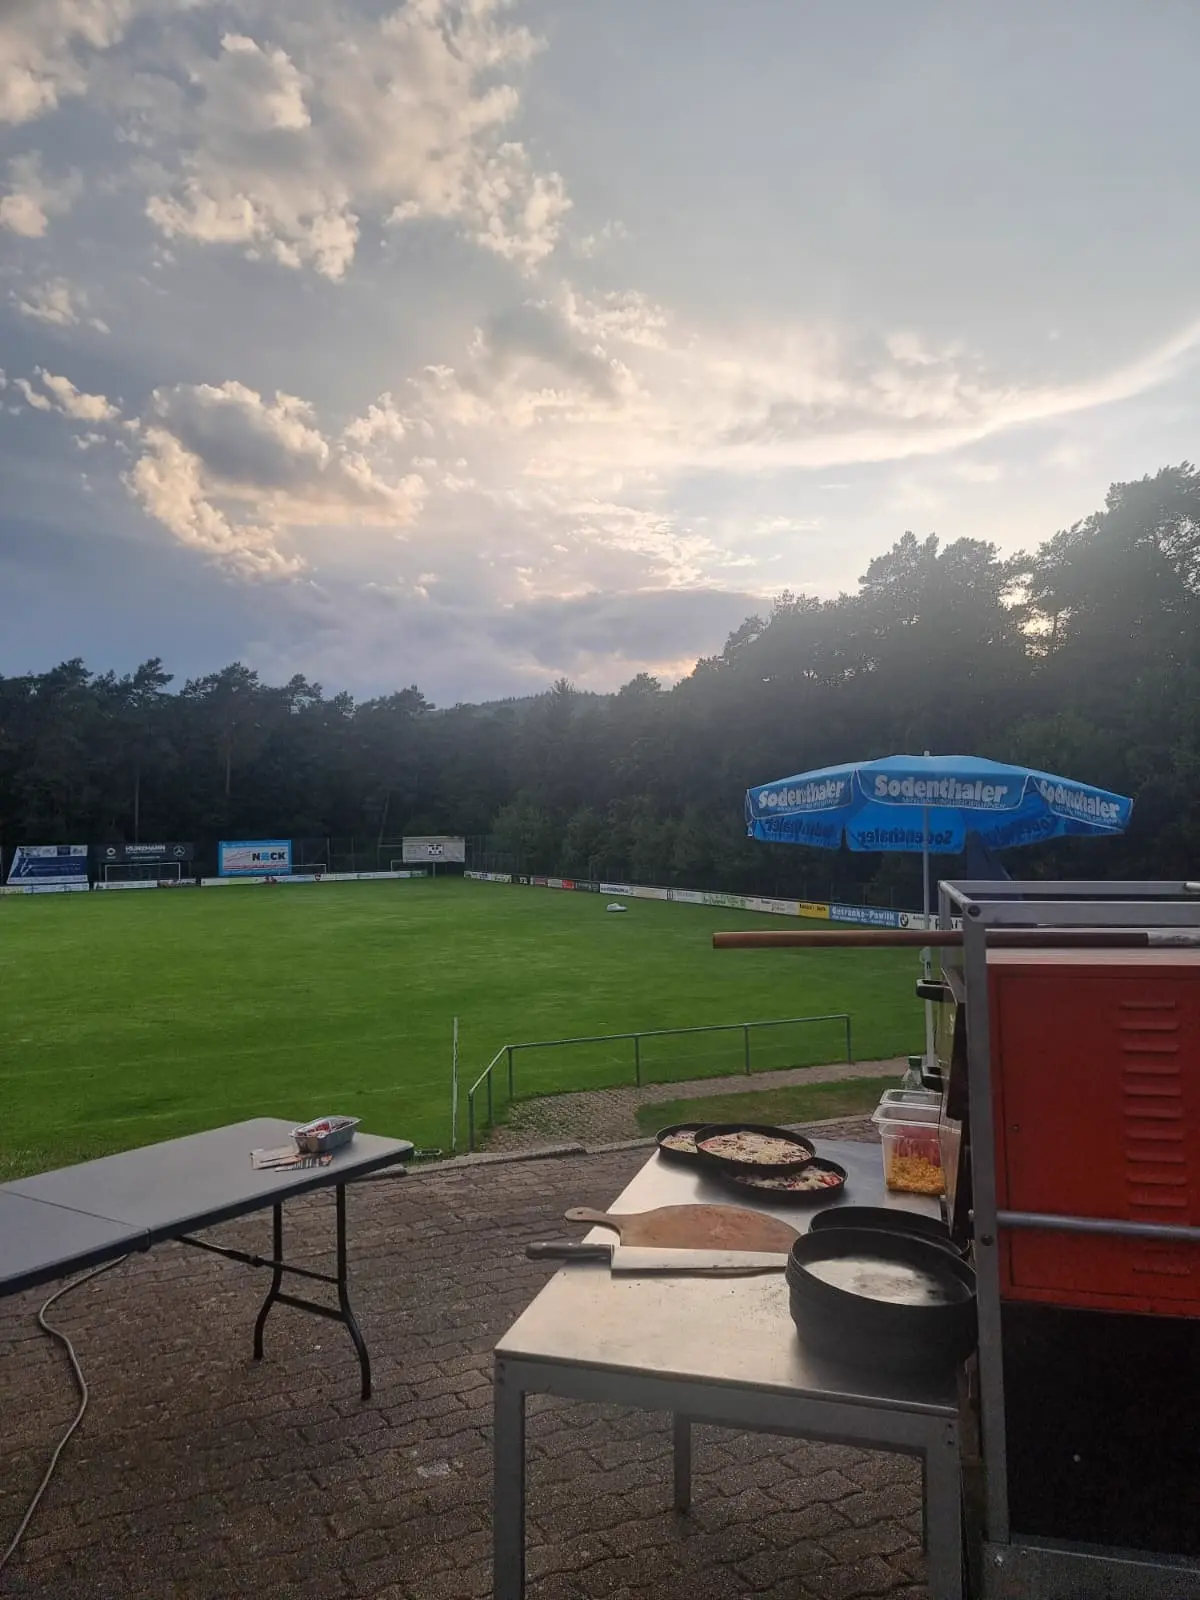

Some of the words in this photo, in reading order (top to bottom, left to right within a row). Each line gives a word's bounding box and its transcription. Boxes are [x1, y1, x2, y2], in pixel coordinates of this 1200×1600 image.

[758, 779, 845, 809] Sodenthaler
[874, 774, 1008, 803] Sodenthaler
[251, 851, 286, 861] NECK
